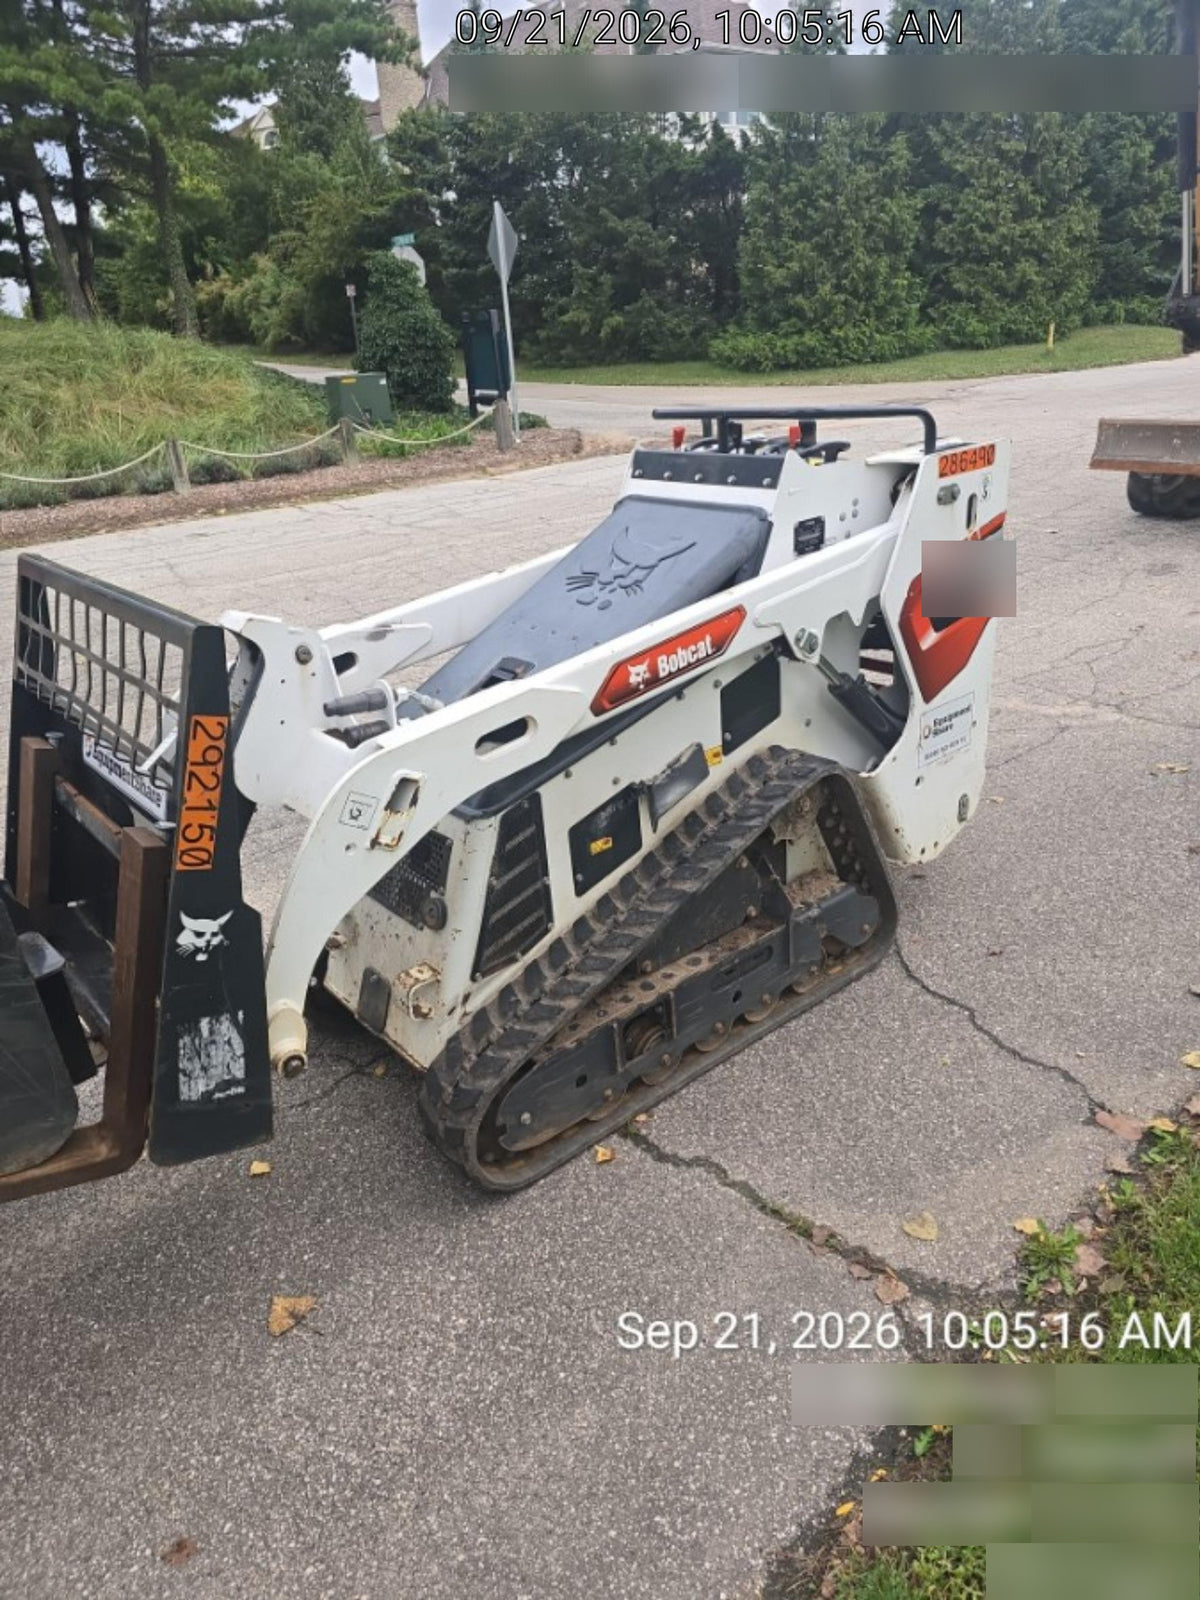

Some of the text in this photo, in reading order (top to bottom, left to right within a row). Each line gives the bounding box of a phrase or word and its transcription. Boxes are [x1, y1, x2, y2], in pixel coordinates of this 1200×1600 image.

[938, 444, 996, 478] 286490
[657, 634, 713, 678] Bobcat
[178, 719, 227, 867] 292150
